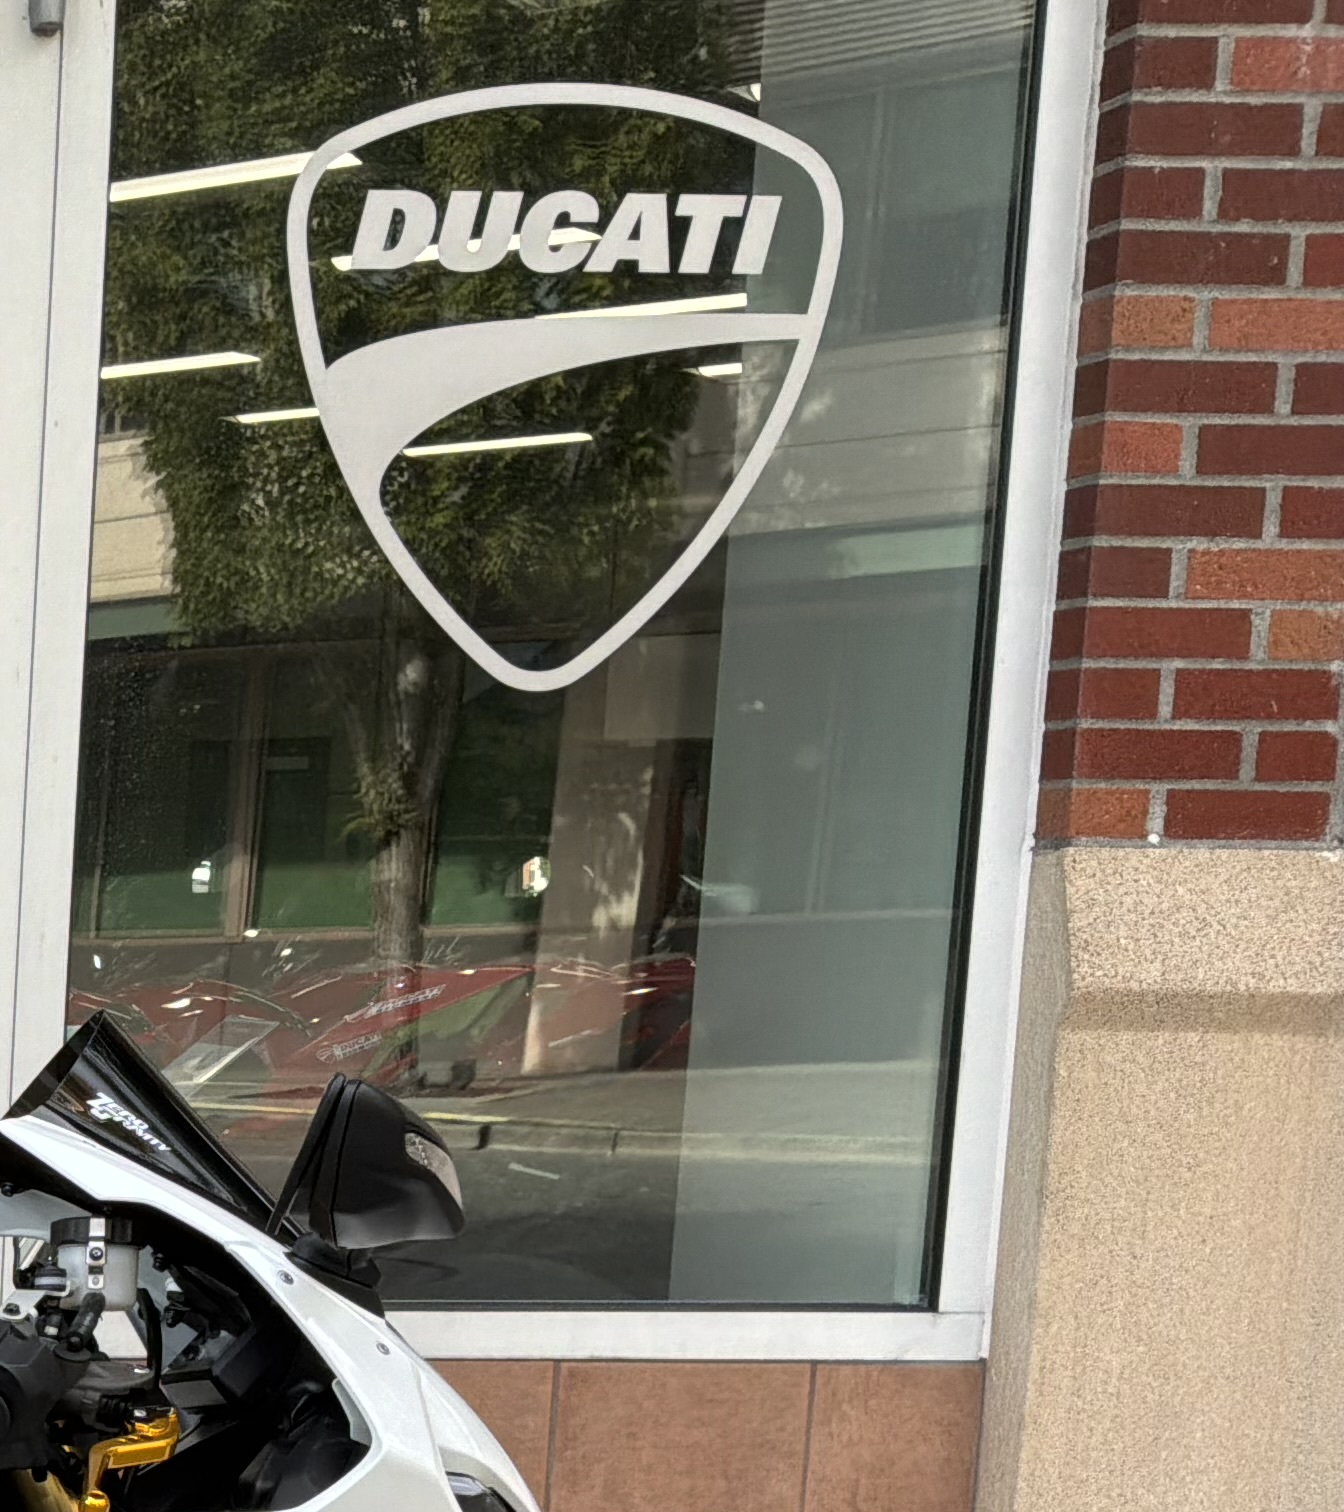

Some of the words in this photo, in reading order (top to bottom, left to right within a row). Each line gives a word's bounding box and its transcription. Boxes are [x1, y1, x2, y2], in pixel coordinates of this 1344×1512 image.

[350, 189, 783, 275] DUCATI
[86, 1091, 149, 1131] ZERO
[89, 1106, 172, 1152] GRAVITY
